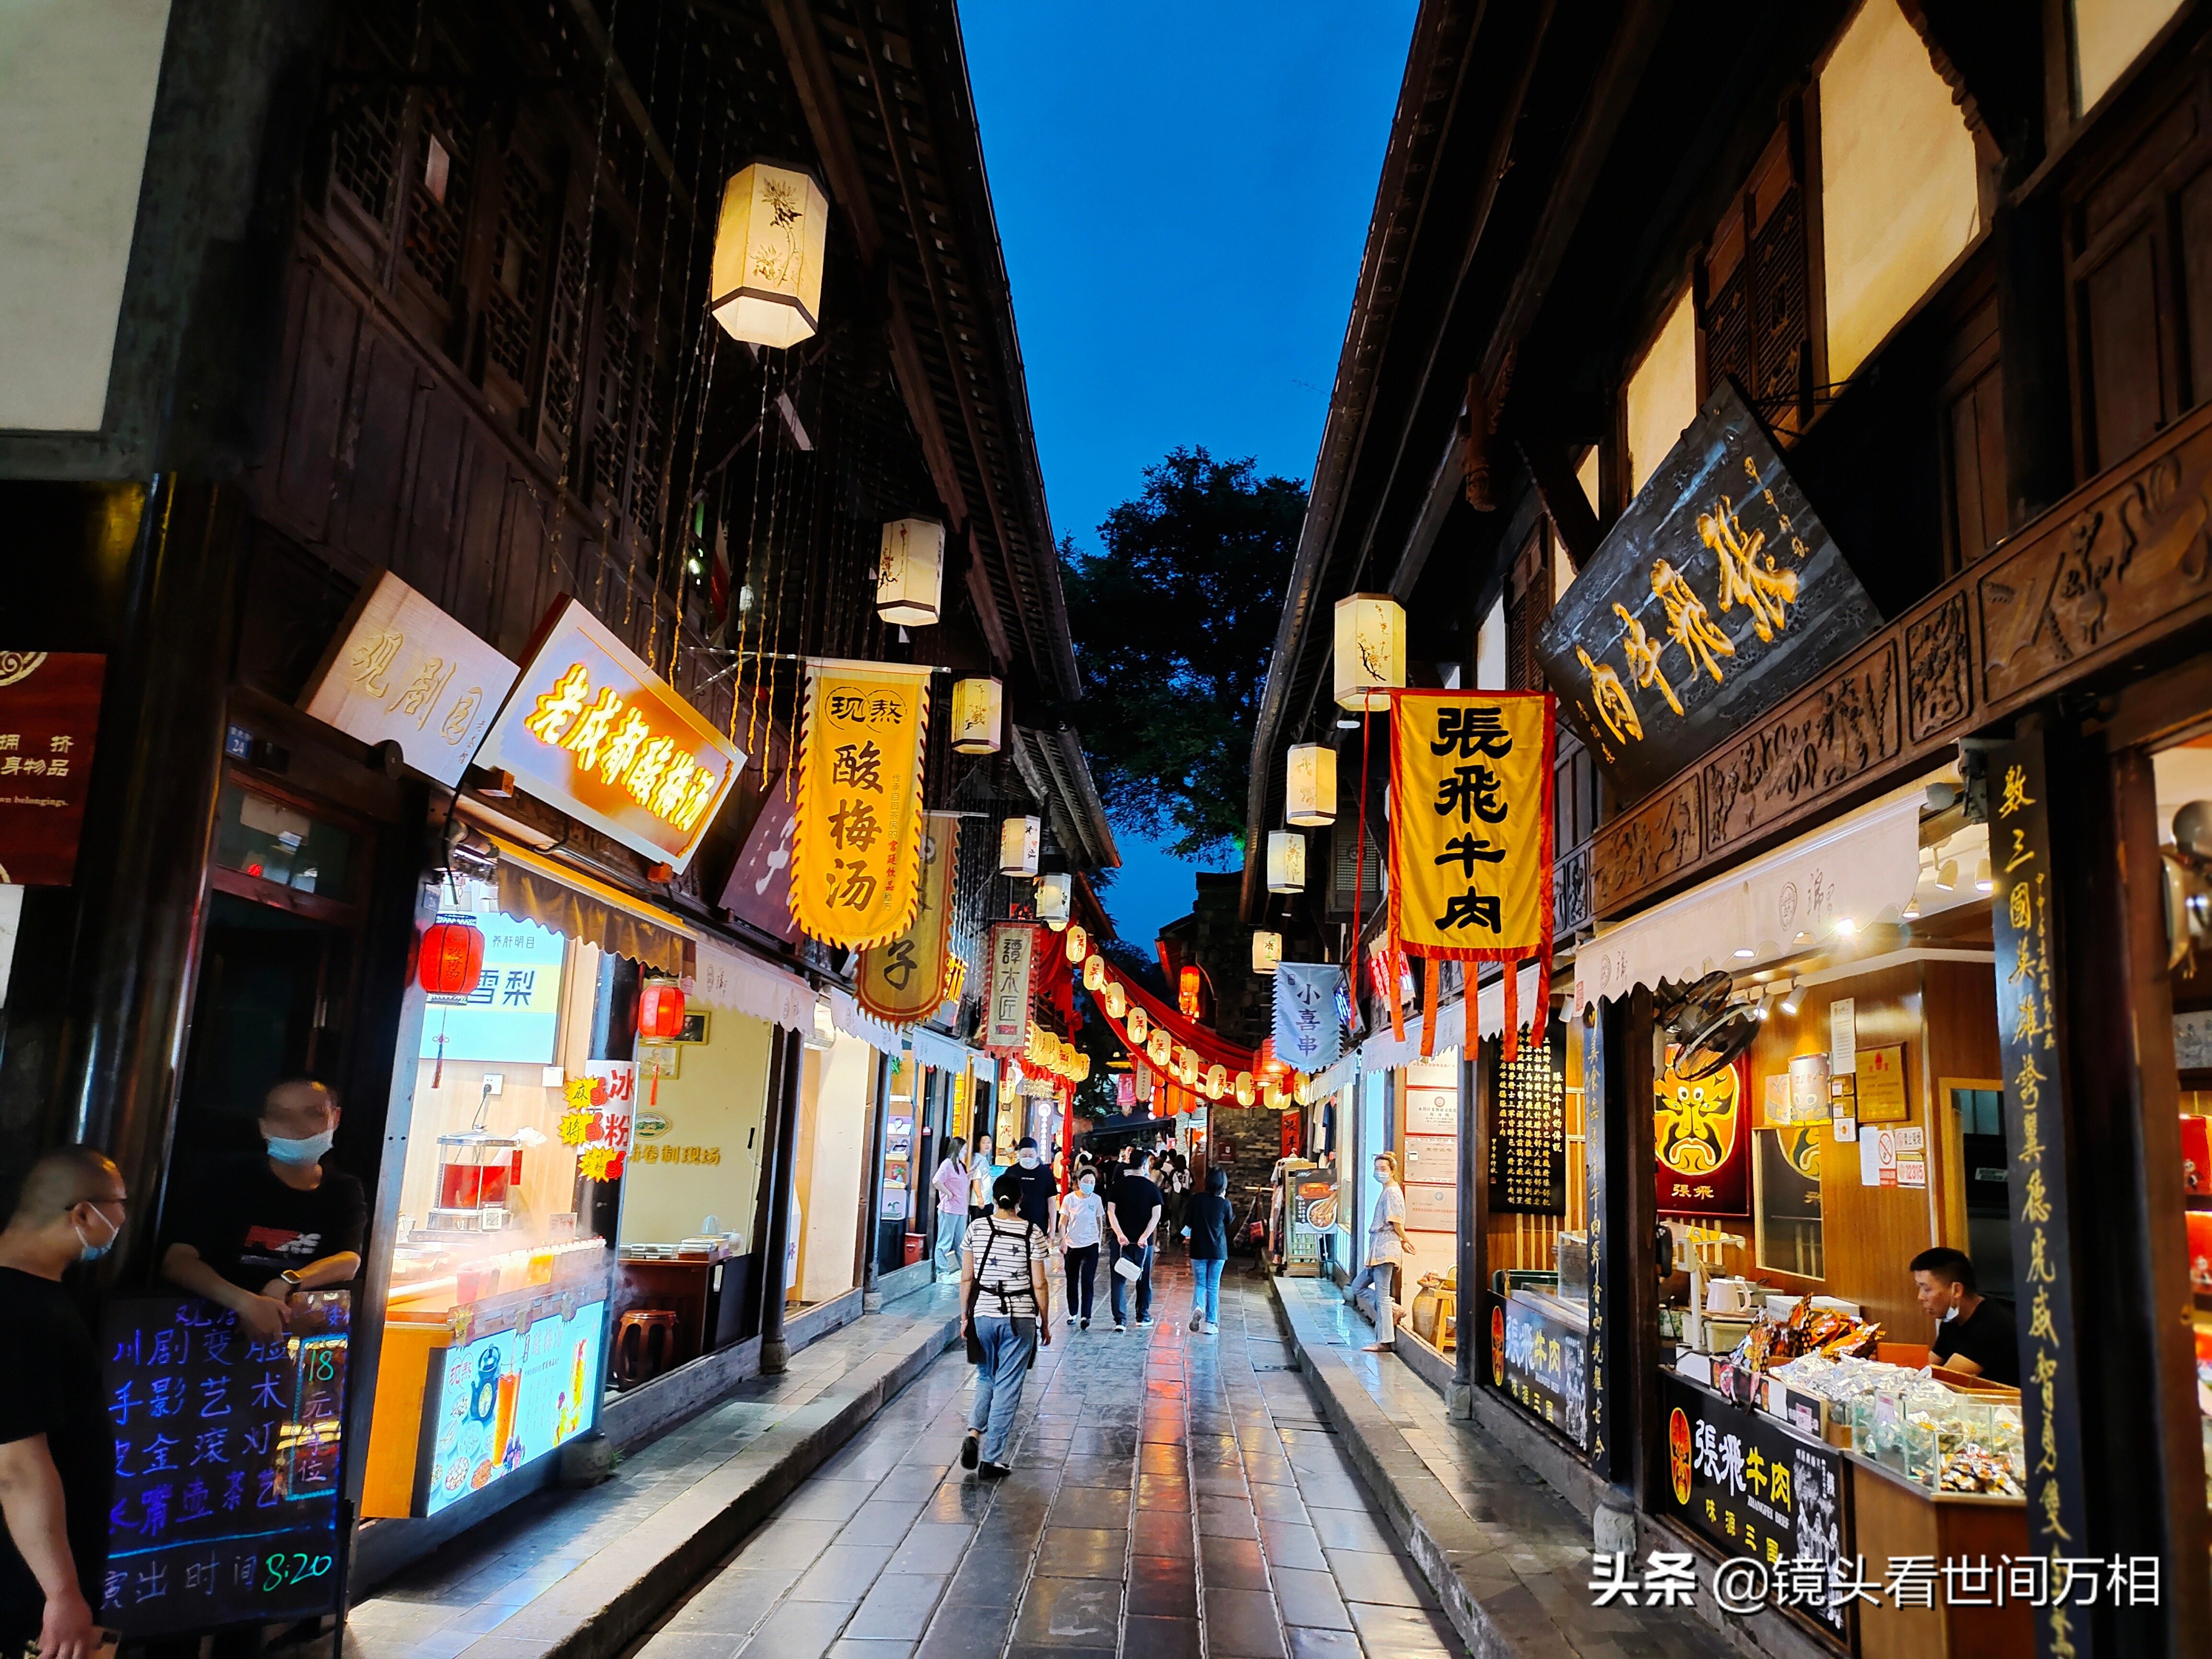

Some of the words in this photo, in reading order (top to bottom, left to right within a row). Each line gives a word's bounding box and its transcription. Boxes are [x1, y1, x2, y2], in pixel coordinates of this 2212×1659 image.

[831, 696, 903, 725] 现熬
[826, 740, 884, 912] 酸梅汤
[1430, 707, 1513, 934] 張飛牛肉
[492, 935, 535, 949] 养肝明目
[1296, 983, 1321, 1058] 小喜串
[604, 1069, 634, 1147] 冰粉
[1671, 1183, 1715, 1200] 張飛
[308, 1349, 334, 1382] 18
[108, 1371, 287, 1425] 手影艺术
[1694, 1419, 1791, 1513] 張飛牛肉
